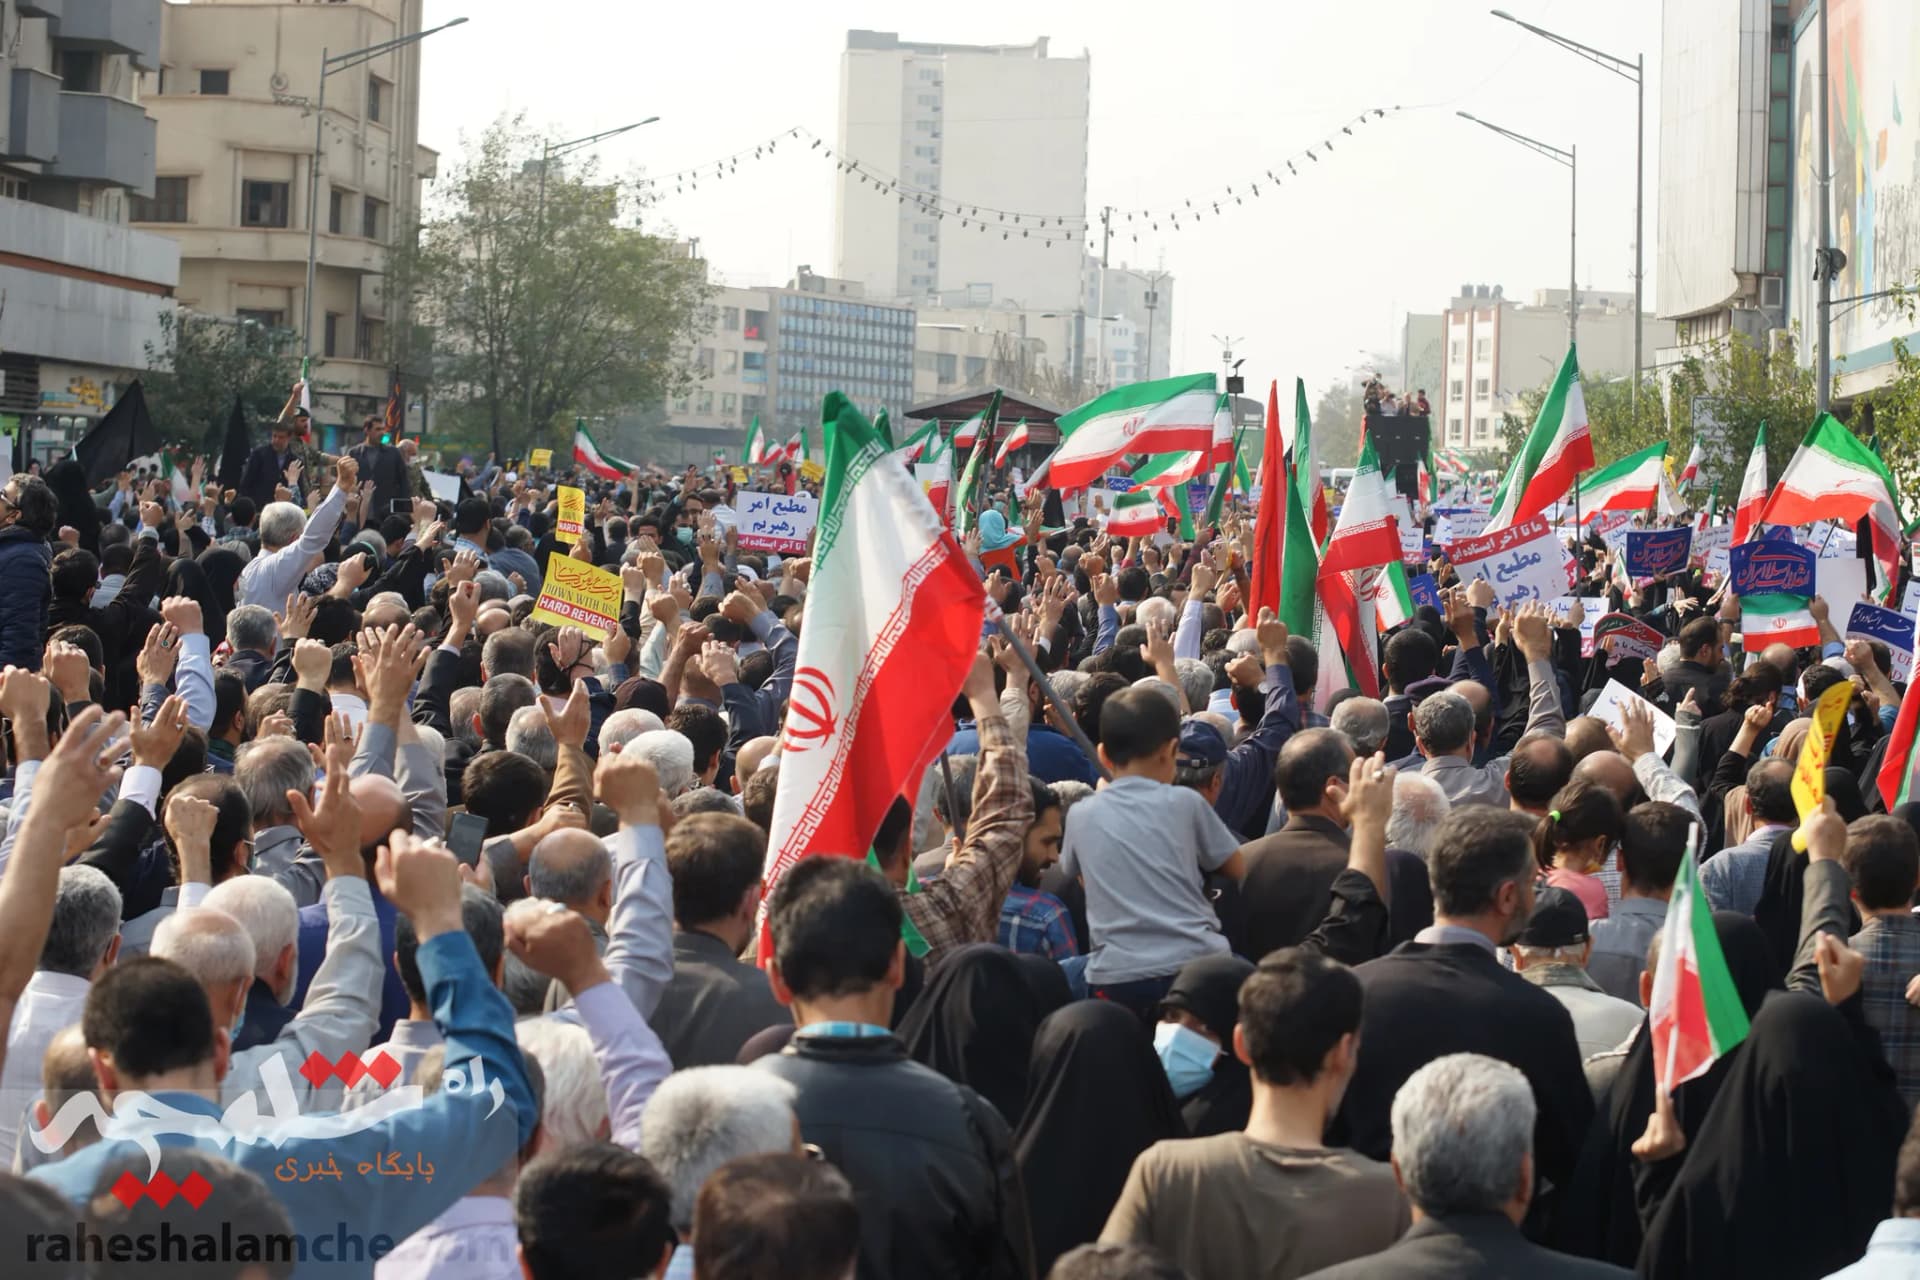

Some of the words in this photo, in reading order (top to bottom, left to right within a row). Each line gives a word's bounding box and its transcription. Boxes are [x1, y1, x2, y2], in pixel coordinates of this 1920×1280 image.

[747, 496, 770, 513] امر
[772, 499, 807, 516] مطیع
[752, 520, 796, 537] رهبریم
[1520, 524, 1530, 537] تا
[1531, 520, 1544, 534] ما
[1463, 536, 1496, 557] ایستاده
[1499, 526, 1519, 550] آخر
[1496, 551, 1542, 583] مطیع
[539, 597, 571, 615] HARD
[545, 583, 574, 601] DOWN
[576, 593, 600, 609] WITH
[602, 601, 618, 617] USA
